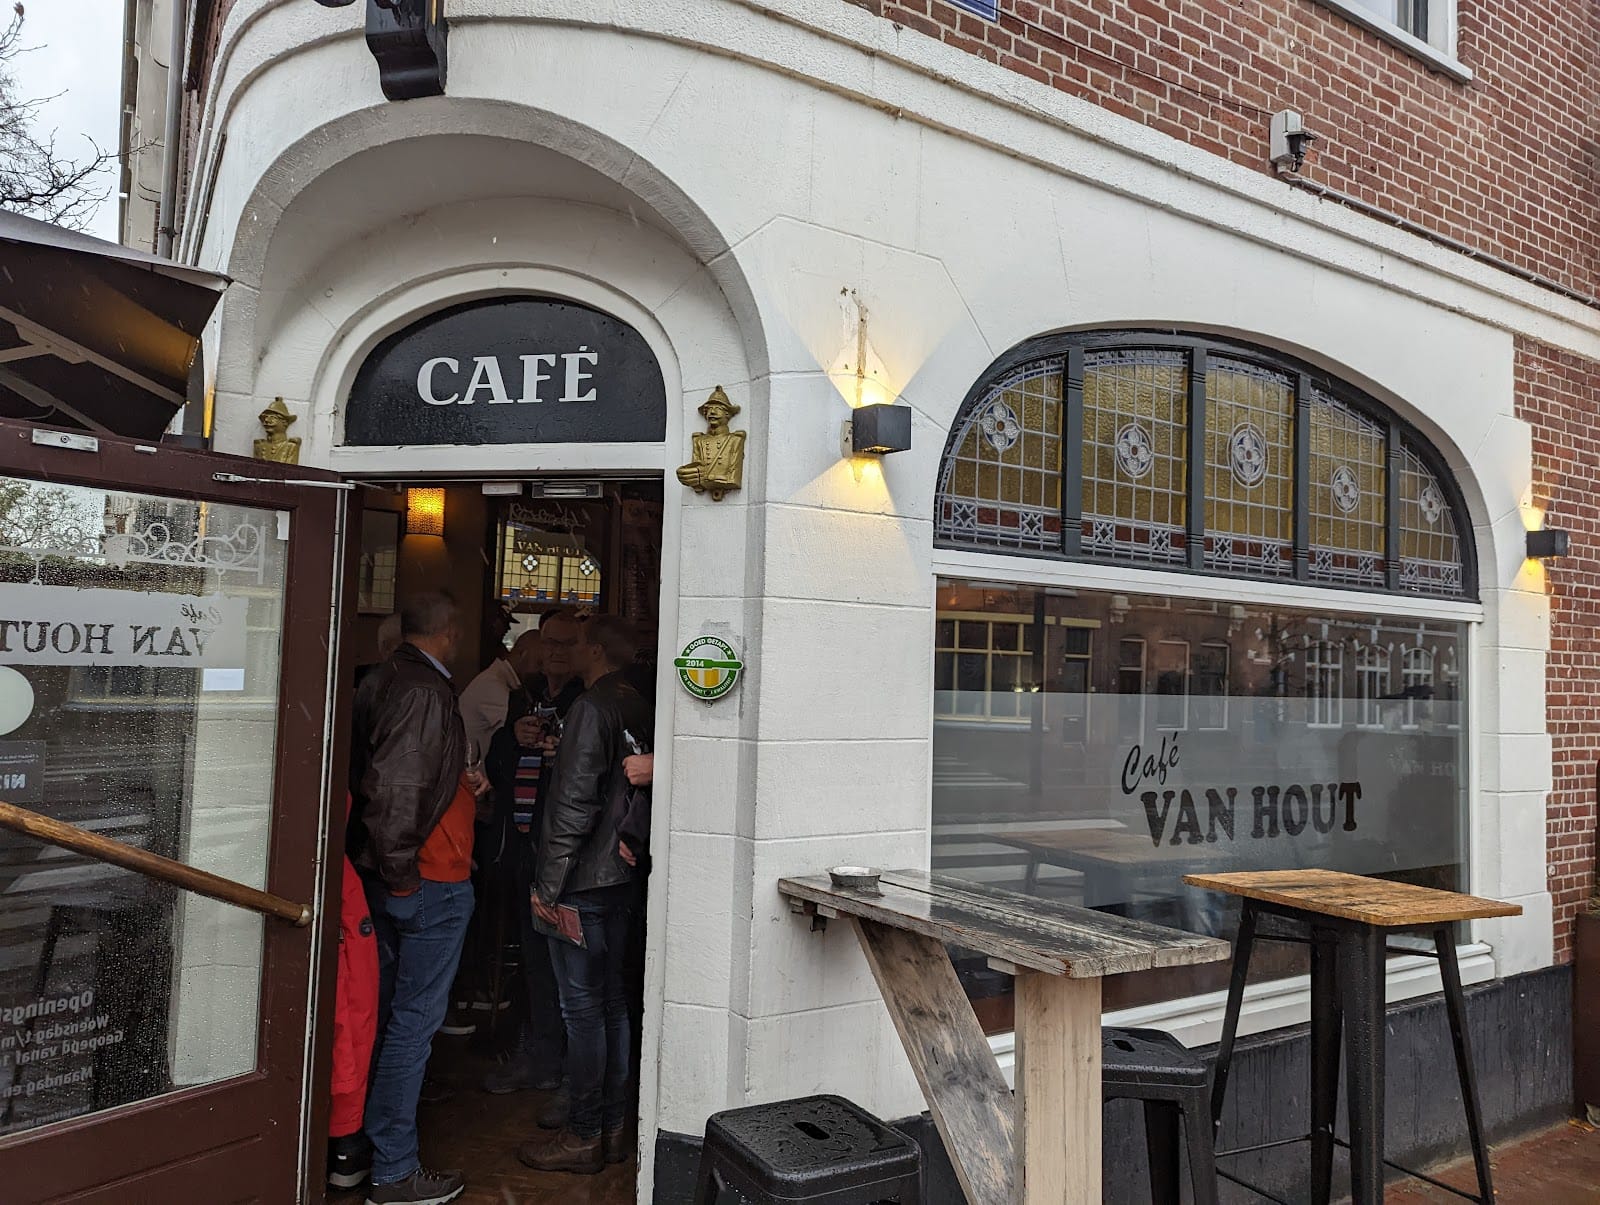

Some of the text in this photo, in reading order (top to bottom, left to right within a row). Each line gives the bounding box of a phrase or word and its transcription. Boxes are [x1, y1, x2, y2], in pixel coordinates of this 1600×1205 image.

[416, 345, 598, 406] CAFÉ
[686, 660, 704, 668] 2014
[1121, 731, 1180, 795] Café
[1140, 781, 1362, 847] VAN HOUT
